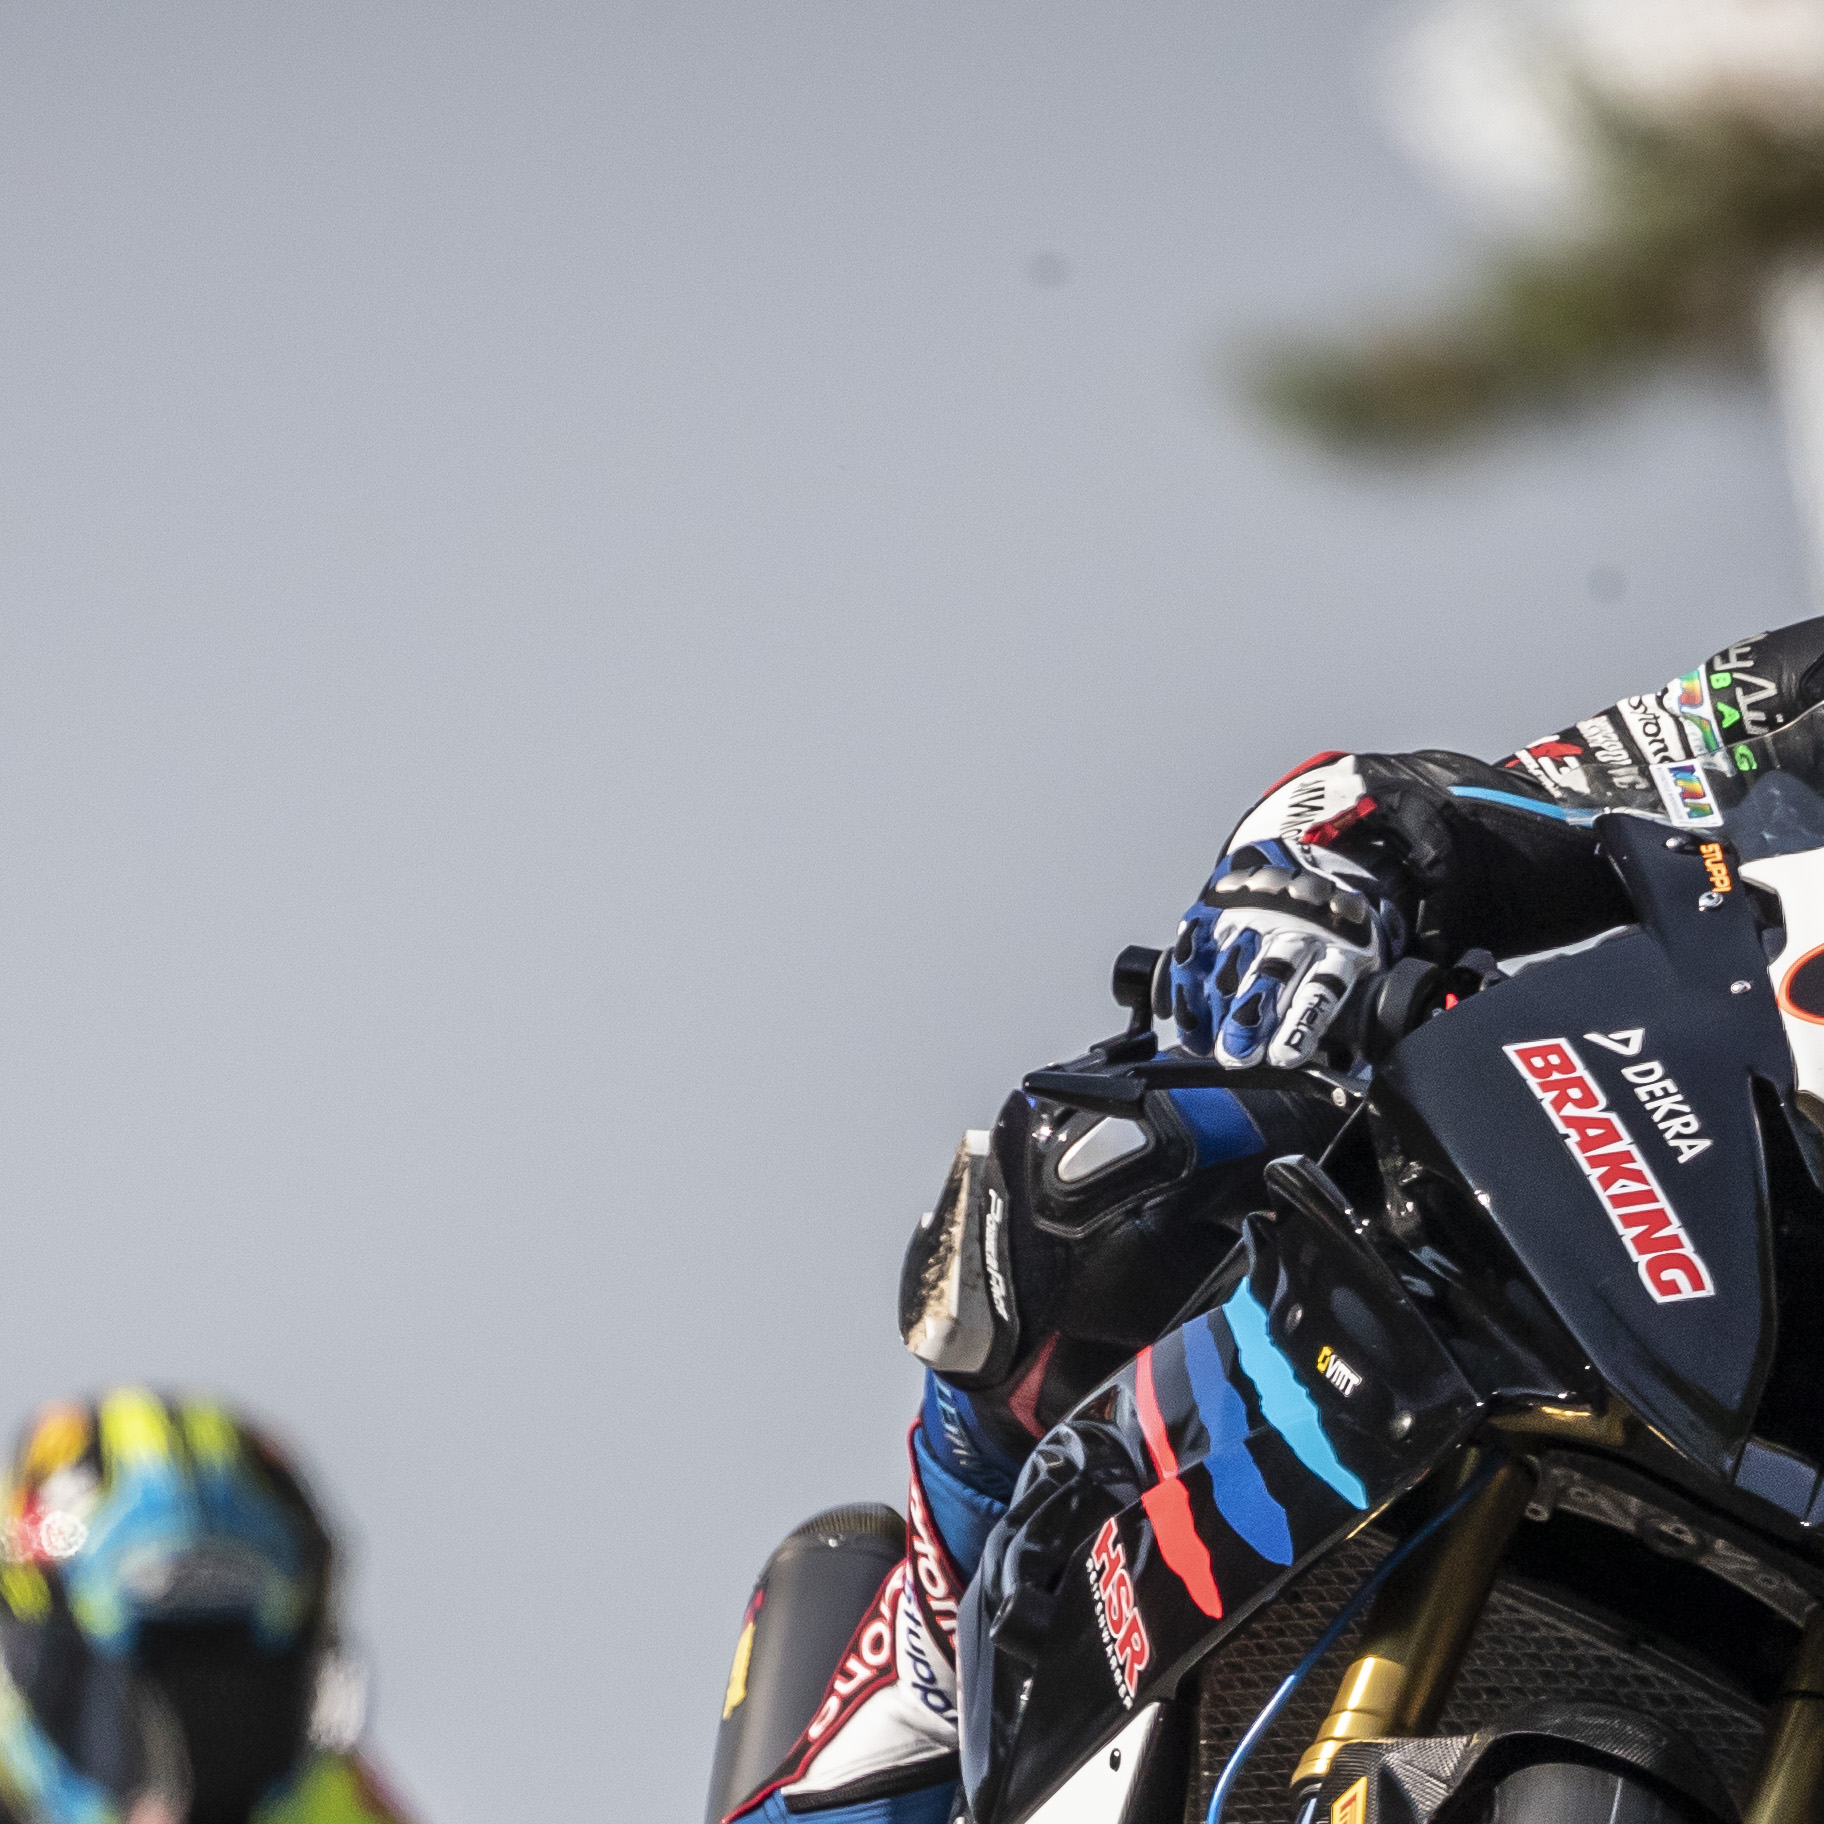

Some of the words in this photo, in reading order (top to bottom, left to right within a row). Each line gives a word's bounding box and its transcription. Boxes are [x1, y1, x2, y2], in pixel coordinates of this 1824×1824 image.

[1699, 842, 1732, 893] STUPPI
[1504, 1039, 1715, 1303] BRAKING
[1622, 1059, 1714, 1164] DEKRA
[1091, 1516, 1150, 1698] HSR
